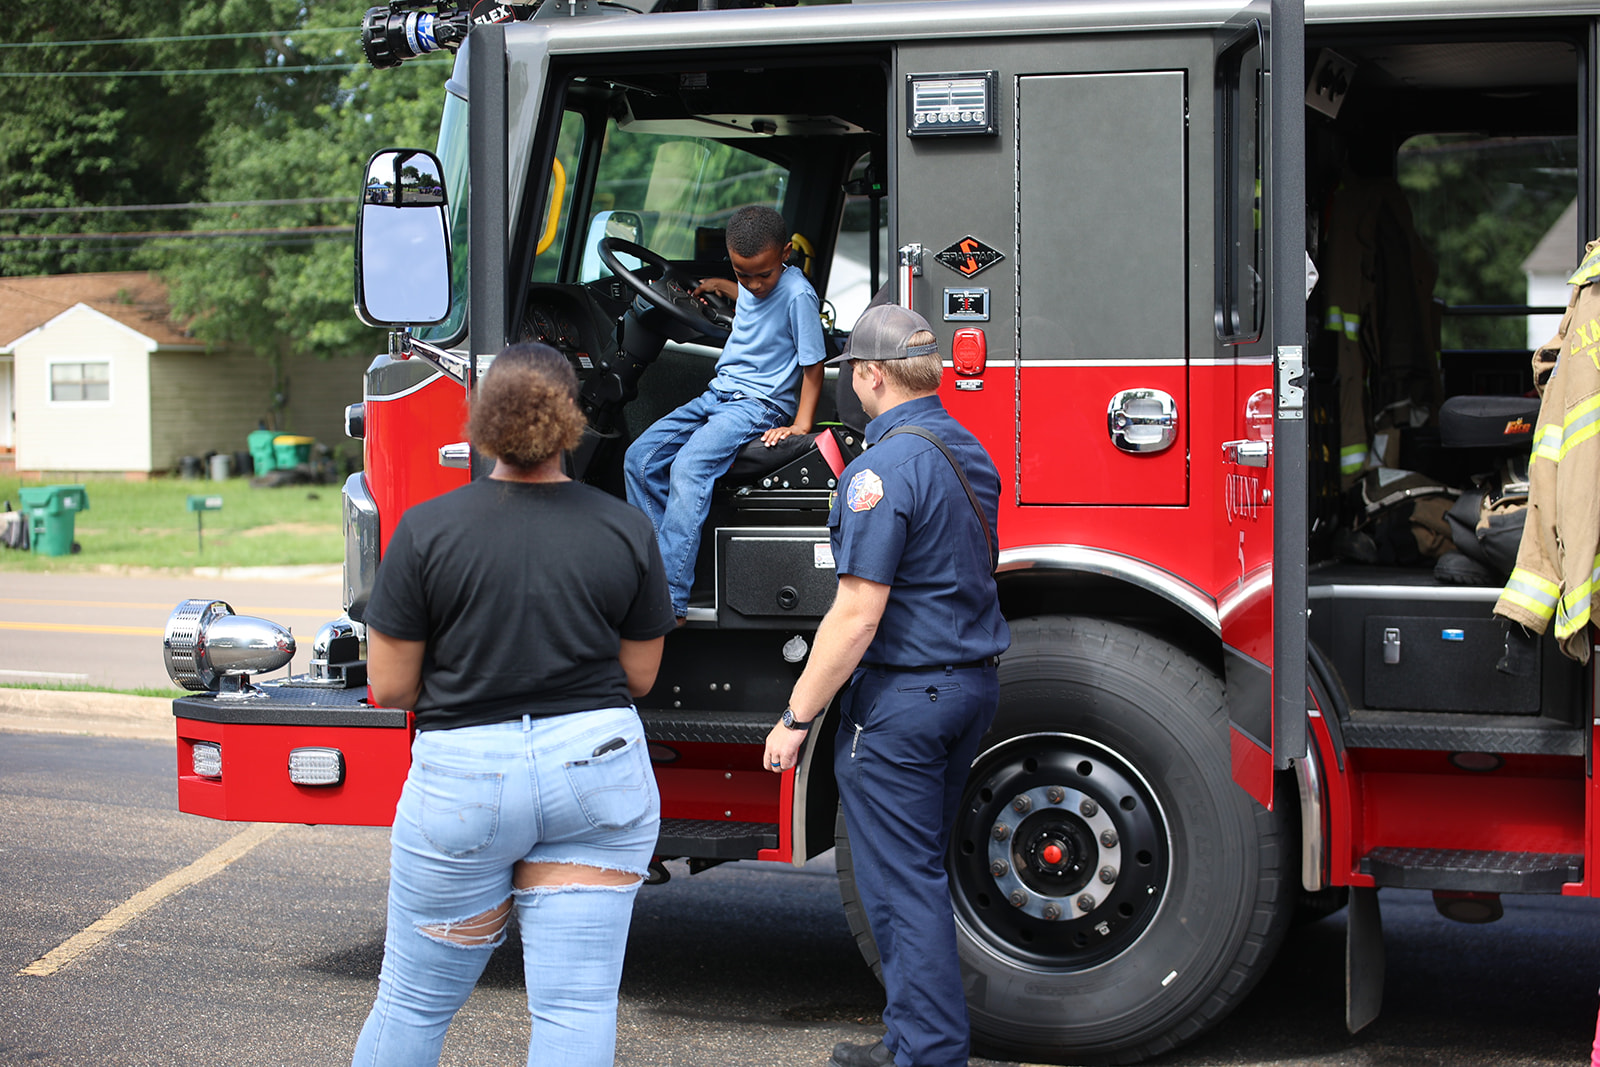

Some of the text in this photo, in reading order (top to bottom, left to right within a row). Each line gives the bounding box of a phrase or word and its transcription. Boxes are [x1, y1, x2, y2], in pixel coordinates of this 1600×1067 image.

[473, 4, 509, 24] FLEX
[941, 250, 996, 261] SPARTAN
[1225, 472, 1259, 523] QUINT
[1237, 530, 1246, 592] 5
